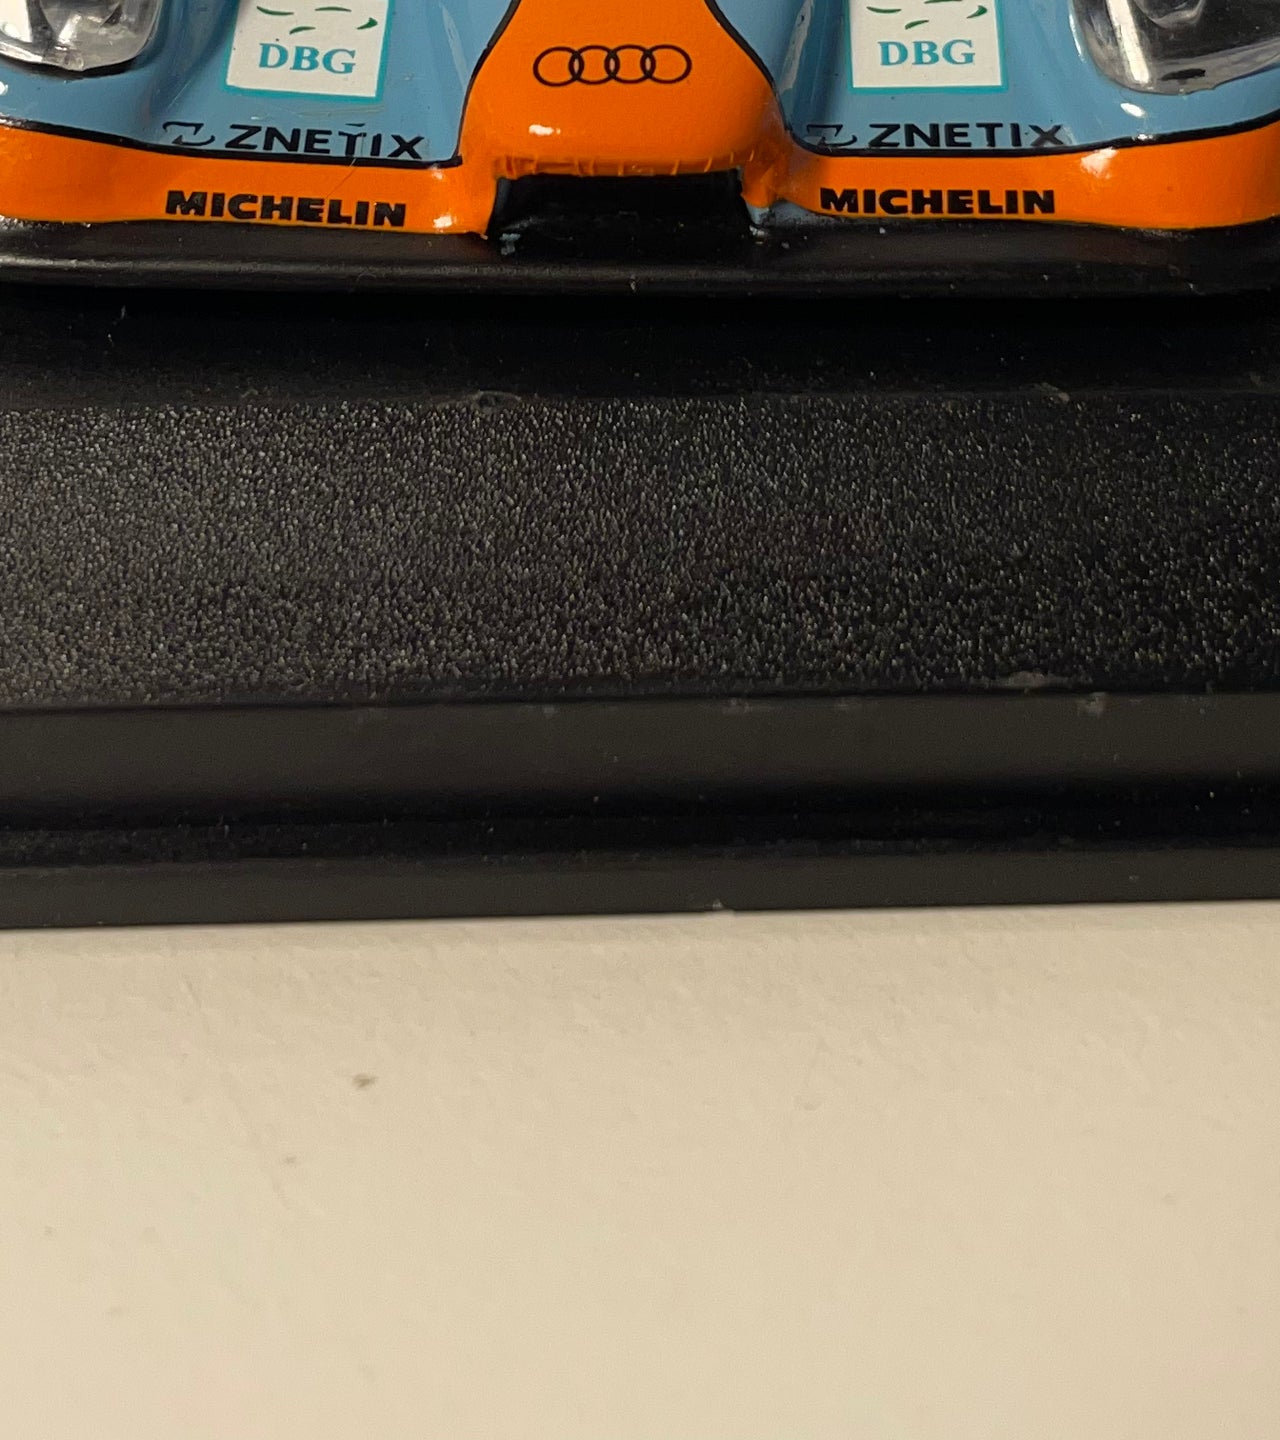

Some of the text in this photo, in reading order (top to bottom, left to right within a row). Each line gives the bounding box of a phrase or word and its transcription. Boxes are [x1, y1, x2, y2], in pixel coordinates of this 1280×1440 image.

[258, 41, 357, 76] DBG
[878, 38, 976, 66] DBG
[223, 123, 425, 160] ZNETIX
[868, 123, 1067, 148] ZNETIX
[165, 190, 407, 227] MICHELIN
[820, 188, 1056, 215] MICHELIN
